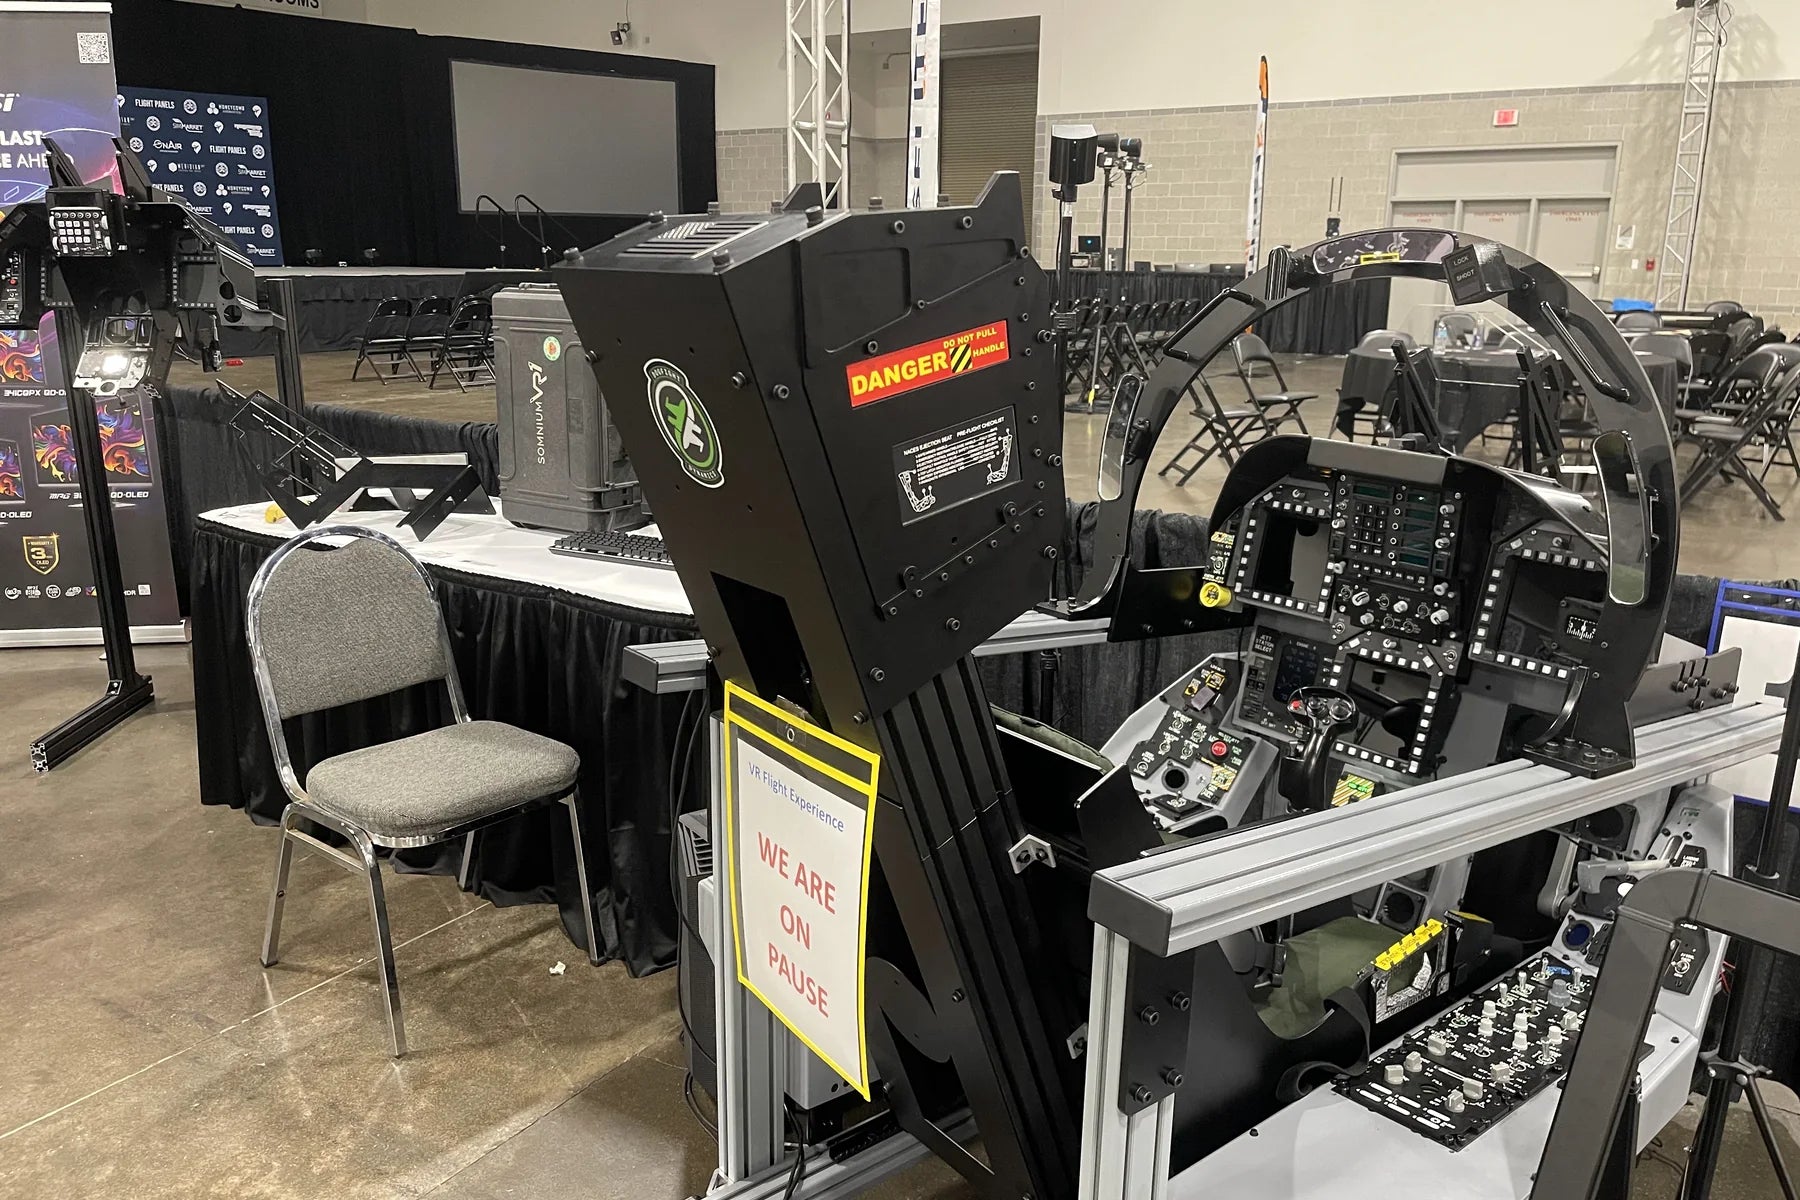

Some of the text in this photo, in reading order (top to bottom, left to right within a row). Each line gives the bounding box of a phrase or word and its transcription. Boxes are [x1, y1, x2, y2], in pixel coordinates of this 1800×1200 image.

[134, 98, 175, 110] FLIGHT PANELS
[209, 144, 247, 156] FLIGHT PANELS
[163, 183, 185, 193] PANELS
[236, 226, 256, 235] PANELS
[1453, 255, 1469, 266] LOCK
[1456, 268, 1475, 282] SHOOT
[943, 327, 997, 349] DO NOT PULL
[851, 341, 1005, 397] DANGER HANDLE
[528, 361, 548, 464] SOMNIUM VR1
[30, 547, 47, 560] 3
[1254, 644, 1273, 653] SELECT
[748, 761, 845, 833] VR Flight Experience
[758, 831, 837, 915] WE ARE
[779, 904, 811, 950] ON
[767, 942, 830, 1018] PAUSE
